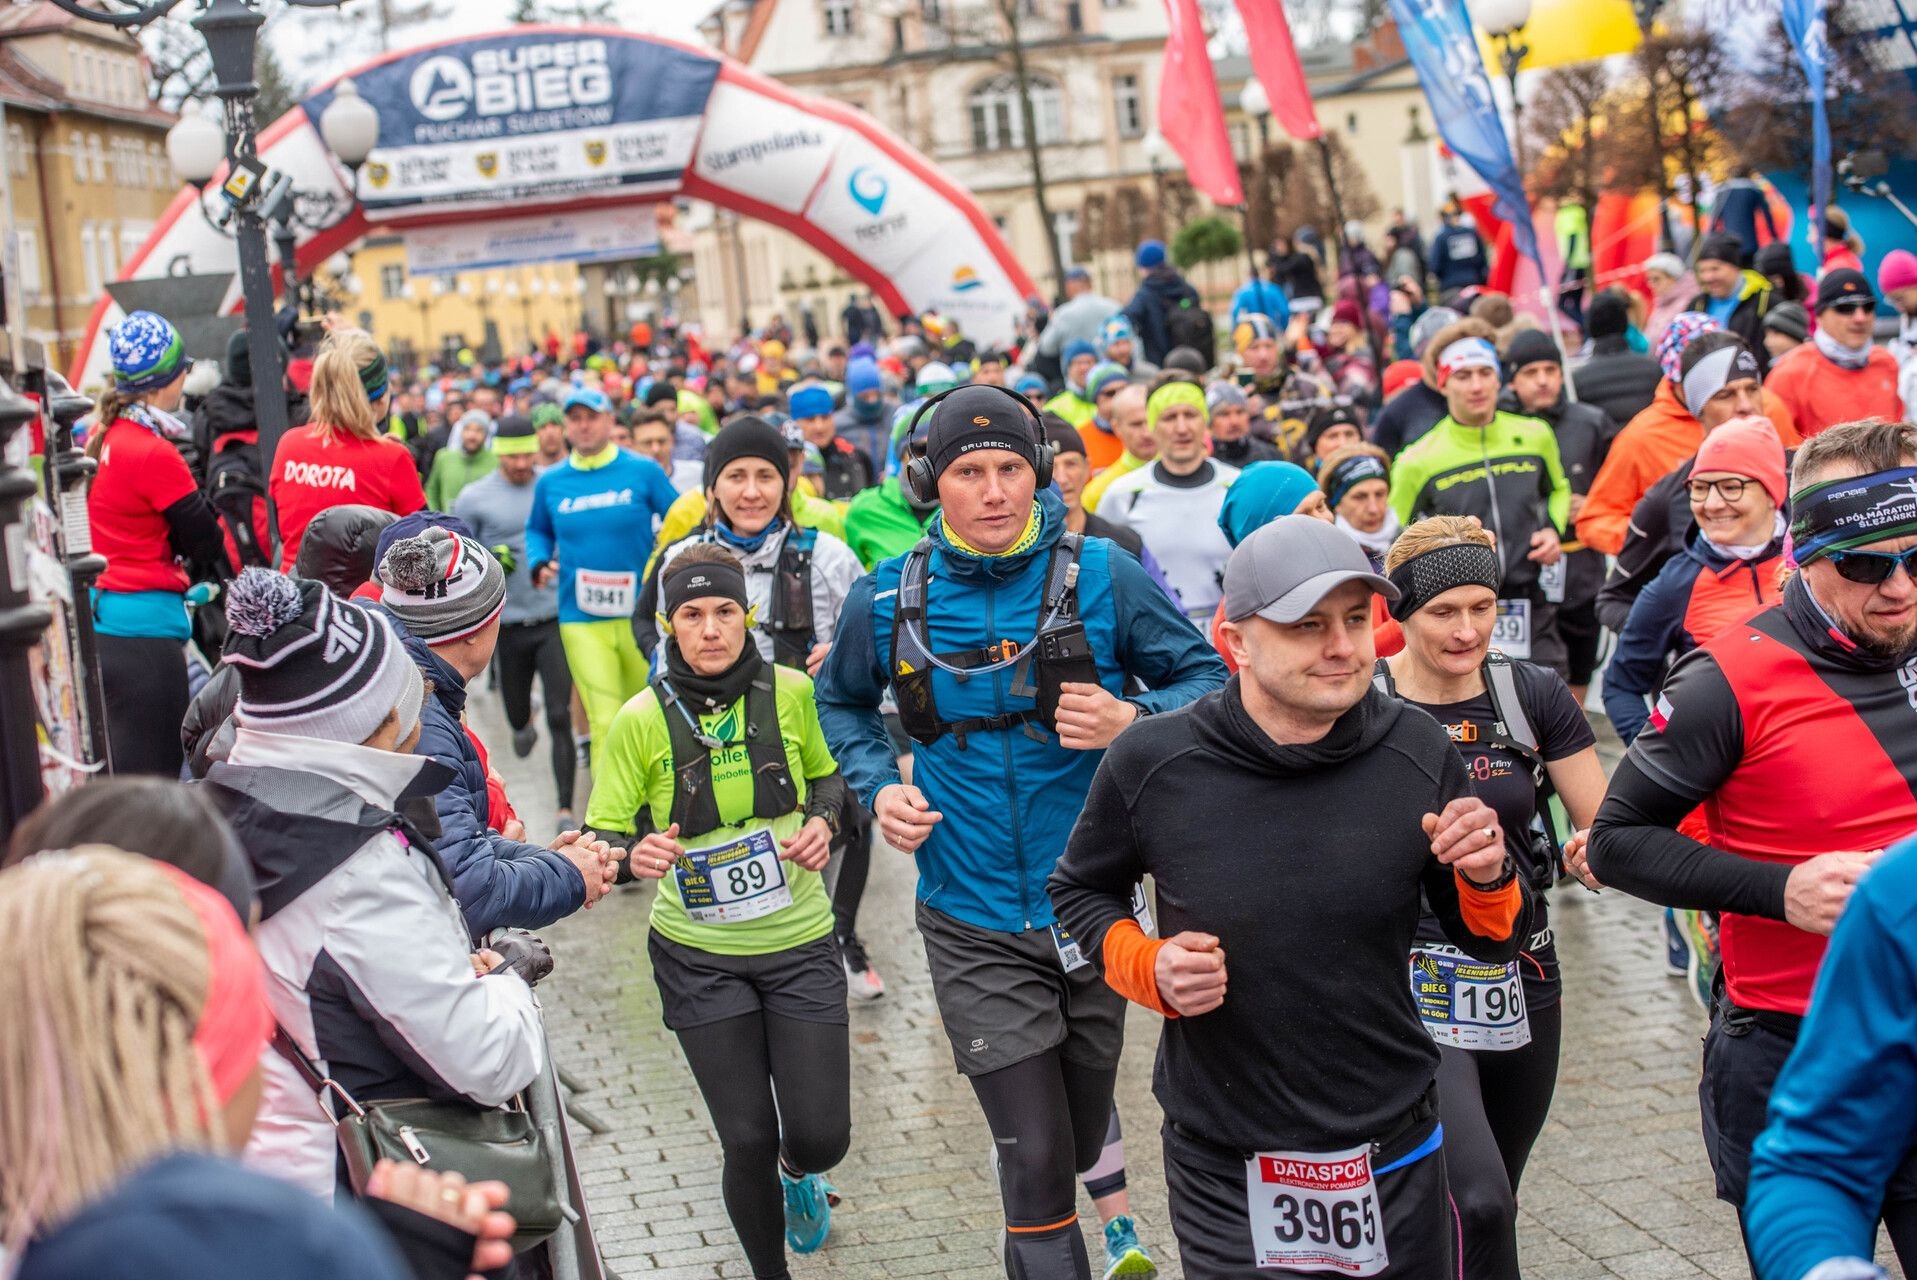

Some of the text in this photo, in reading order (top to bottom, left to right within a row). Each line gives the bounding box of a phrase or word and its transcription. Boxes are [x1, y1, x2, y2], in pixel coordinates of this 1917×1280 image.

[471, 39, 608, 73] SUPER
[475, 63, 613, 116] BIEG
[415, 118, 501, 142] PUCHAR
[961, 441, 1011, 452] BRUBECK
[284, 460, 356, 492] DOROTA
[1834, 503, 1916, 526] 13 PÓŁMARATON
[684, 876, 705, 886] BIEG
[727, 860, 766, 896] 89
[1421, 983, 1447, 993] BIEG
[1462, 981, 1520, 1021] 196
[1431, 1010, 1449, 1019] GÓRY
[1280, 1177, 1329, 1190] ELEKTRONICZNY
[1331, 1181, 1356, 1190] POMIAR
[1273, 1193, 1376, 1250] 3965
